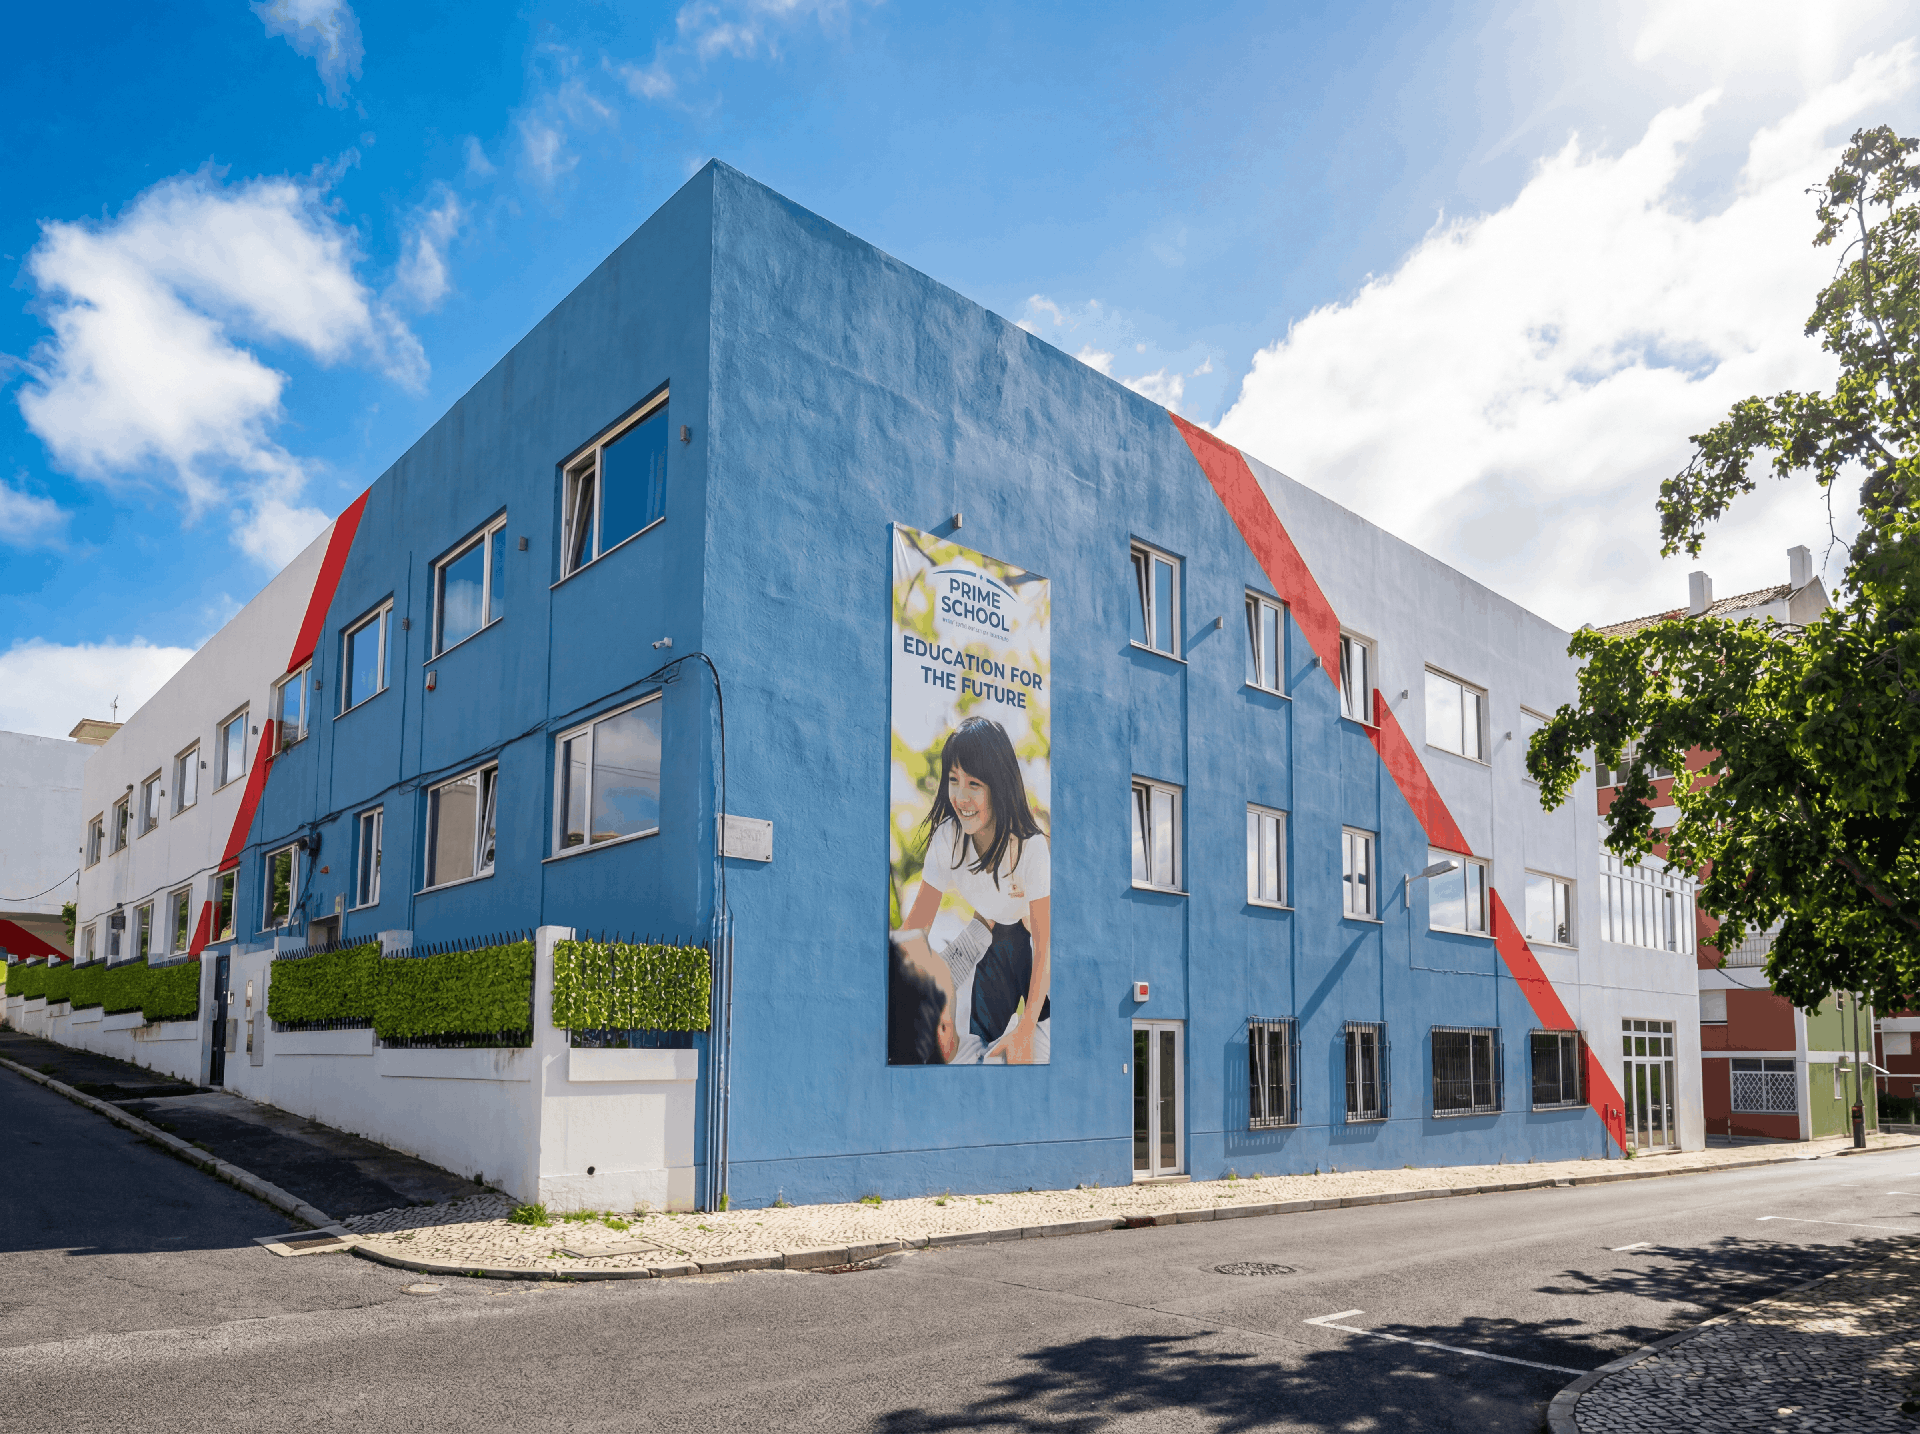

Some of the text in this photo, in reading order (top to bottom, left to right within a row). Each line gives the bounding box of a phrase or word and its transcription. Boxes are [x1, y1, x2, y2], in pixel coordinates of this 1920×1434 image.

[941, 595, 1010, 632] SCHOOL
[950, 577, 1000, 610] PRIME
[903, 635, 1042, 691] EDUCATION FOR
[920, 664, 1027, 709] THE FUTURE
